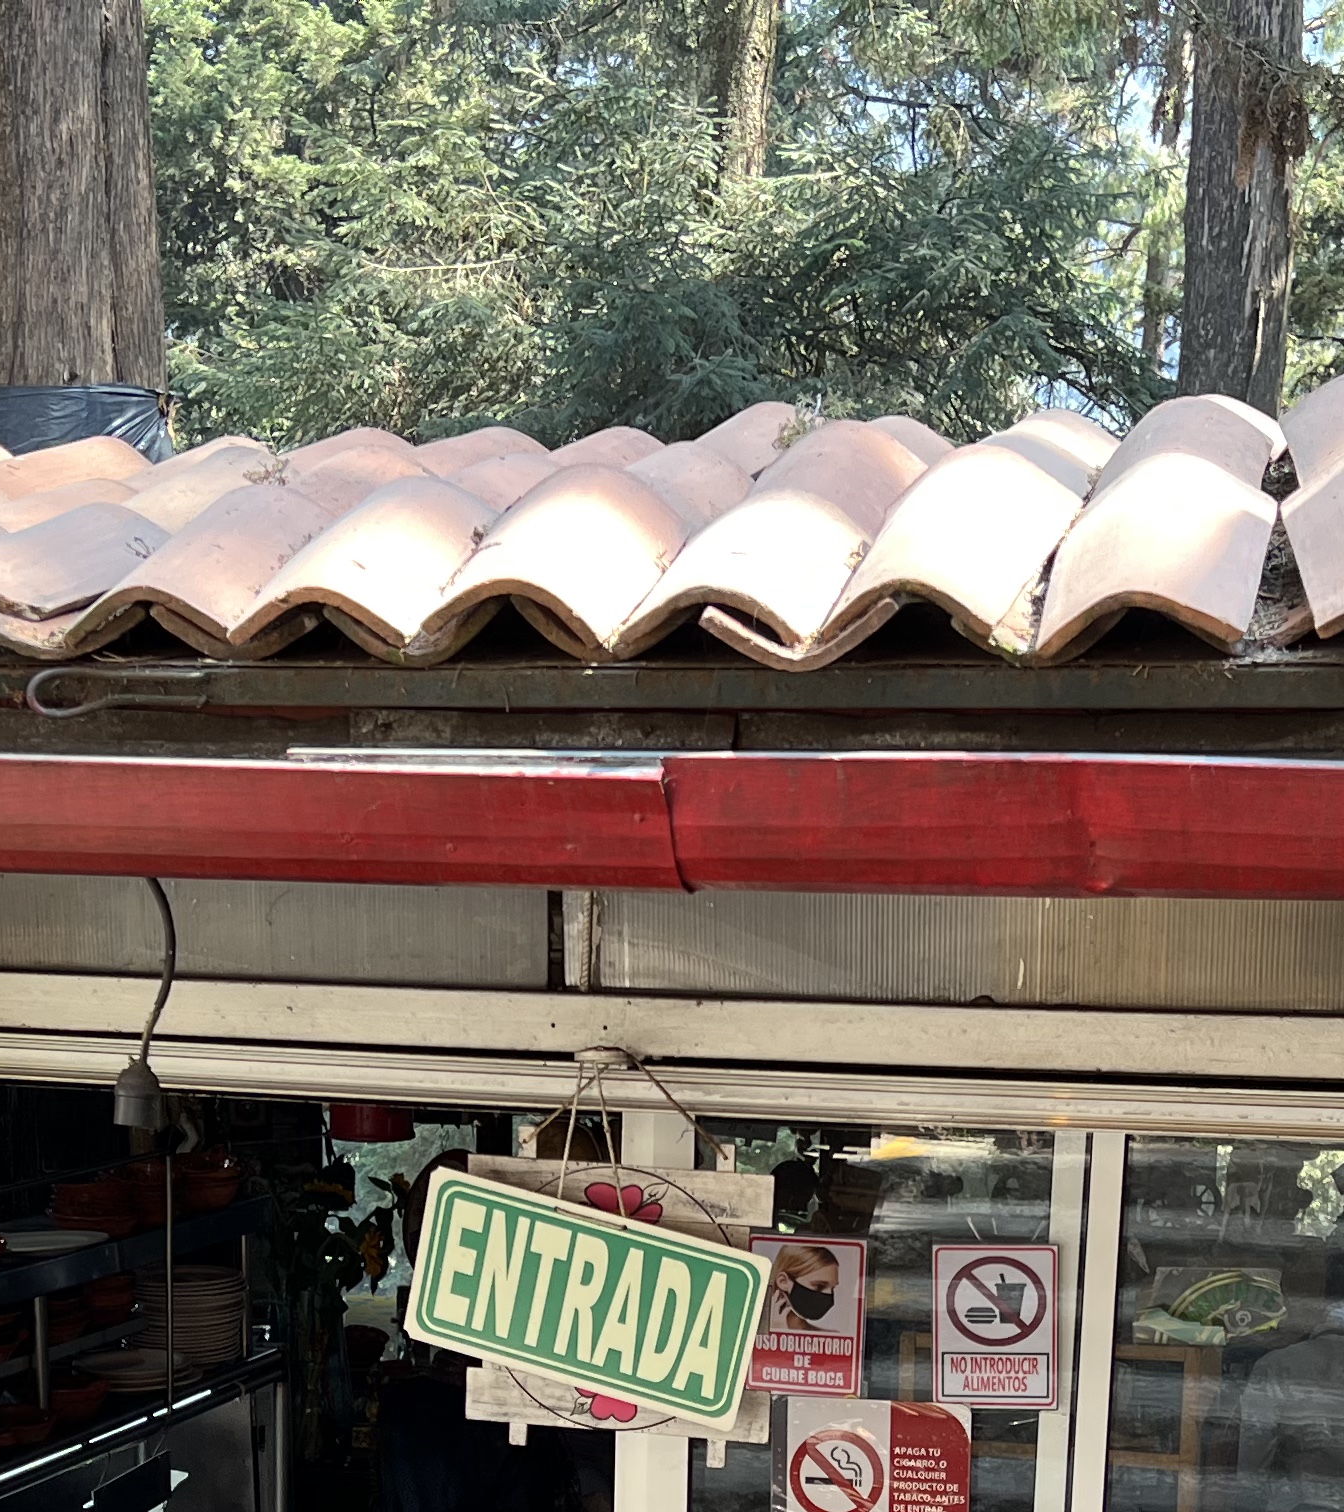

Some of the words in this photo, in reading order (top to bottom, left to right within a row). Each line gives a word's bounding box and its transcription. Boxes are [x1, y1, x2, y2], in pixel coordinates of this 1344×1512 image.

[433, 1197, 727, 1400] ENTRADA
[756, 1334, 777, 1350] USO
[780, 1334, 852, 1356] OBLIGATORIO
[794, 1354, 811, 1368] DE
[950, 1356, 967, 1374] NO
[970, 1356, 1039, 1375] INTRODUCIR
[762, 1367, 805, 1384] CUBRE
[808, 1370, 844, 1386] BOCA
[962, 1375, 1027, 1392] ALIMENTOS
[893, 1446, 926, 1456] APAGA
[928, 1448, 941, 1457] TU
[893, 1458, 937, 1468] CIGARRO,
[939, 1460, 947, 1469] O
[893, 1469, 946, 1480] CUALQUIER
[893, 1481, 945, 1491] PRODUCTO
[946, 1483, 959, 1492] DE
[936, 1494, 965, 1504] ANTES
[893, 1504, 906, 1512] DE
